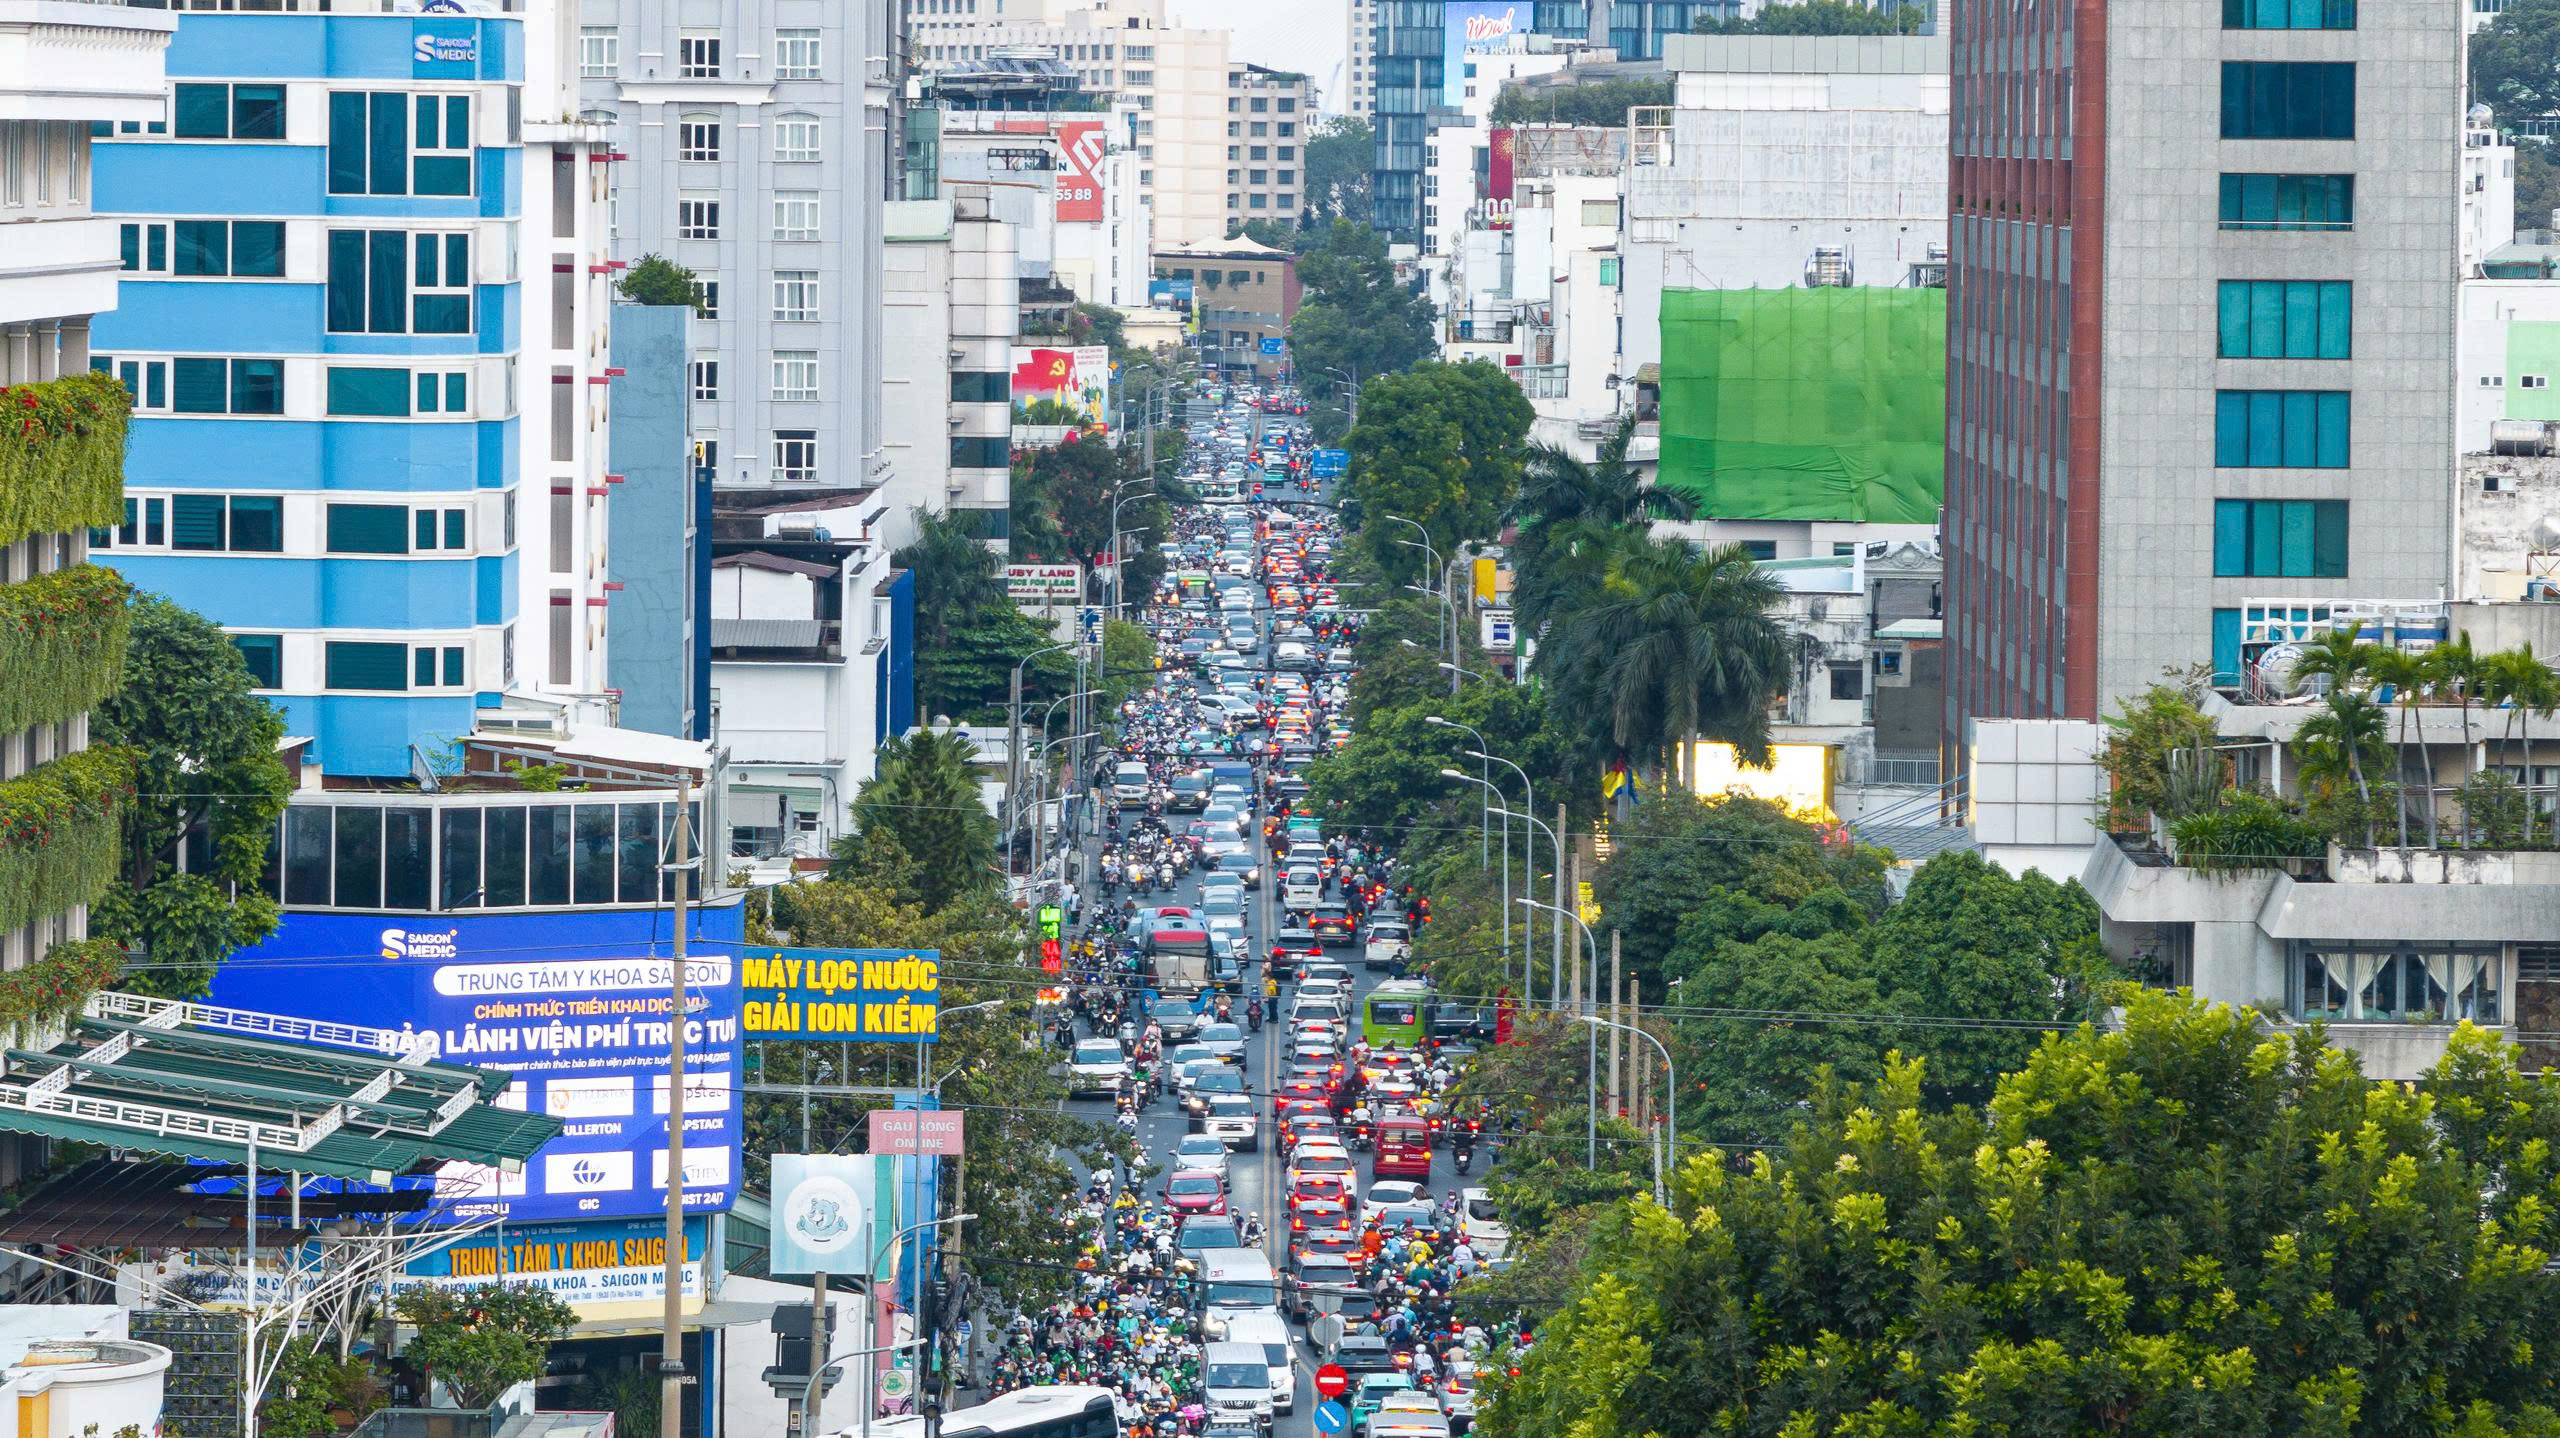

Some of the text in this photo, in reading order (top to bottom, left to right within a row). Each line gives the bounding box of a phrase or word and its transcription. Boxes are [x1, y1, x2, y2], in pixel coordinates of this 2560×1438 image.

[1075, 188, 1092, 200] 88
[1039, 569, 1075, 577] LAND
[408, 934, 451, 944] SAIGON
[408, 944, 456, 958] MEDIC
[457, 973, 523, 991] TRUNG
[528, 967, 568, 989] TÂM
[573, 969, 585, 987] Y
[590, 967, 644, 986] KHOA
[648, 962, 672, 984] SÀ
[742, 952, 938, 996] MÁY LỌC NƯỚC
[474, 1001, 522, 1019] CHÍNH
[524, 999, 565, 1017] THỨC
[611, 999, 646, 1014] KHAI
[650, 998, 673, 1015] DỊC
[743, 991, 800, 1032] GIẢI
[807, 1002, 857, 1032] ION
[445, 1022, 518, 1053] LÃNH
[522, 1018, 582, 1056] VIỆN
[586, 1016, 631, 1049] PHÍ
[563, 1122, 622, 1136] ULLERTON
[663, 1117, 724, 1132] LPSTACK
[577, 1198, 600, 1210] GIC
[513, 1237, 551, 1273] TÂM
[556, 1242, 567, 1272] Y
[571, 1239, 619, 1270] KHOA
[623, 1235, 688, 1267] SAIGN
[553, 1276, 587, 1291] KHOA
[602, 1272, 648, 1288] SAIGON
[653, 1269, 693, 1286] MIC
[680, 1375, 698, 1385] 05A
